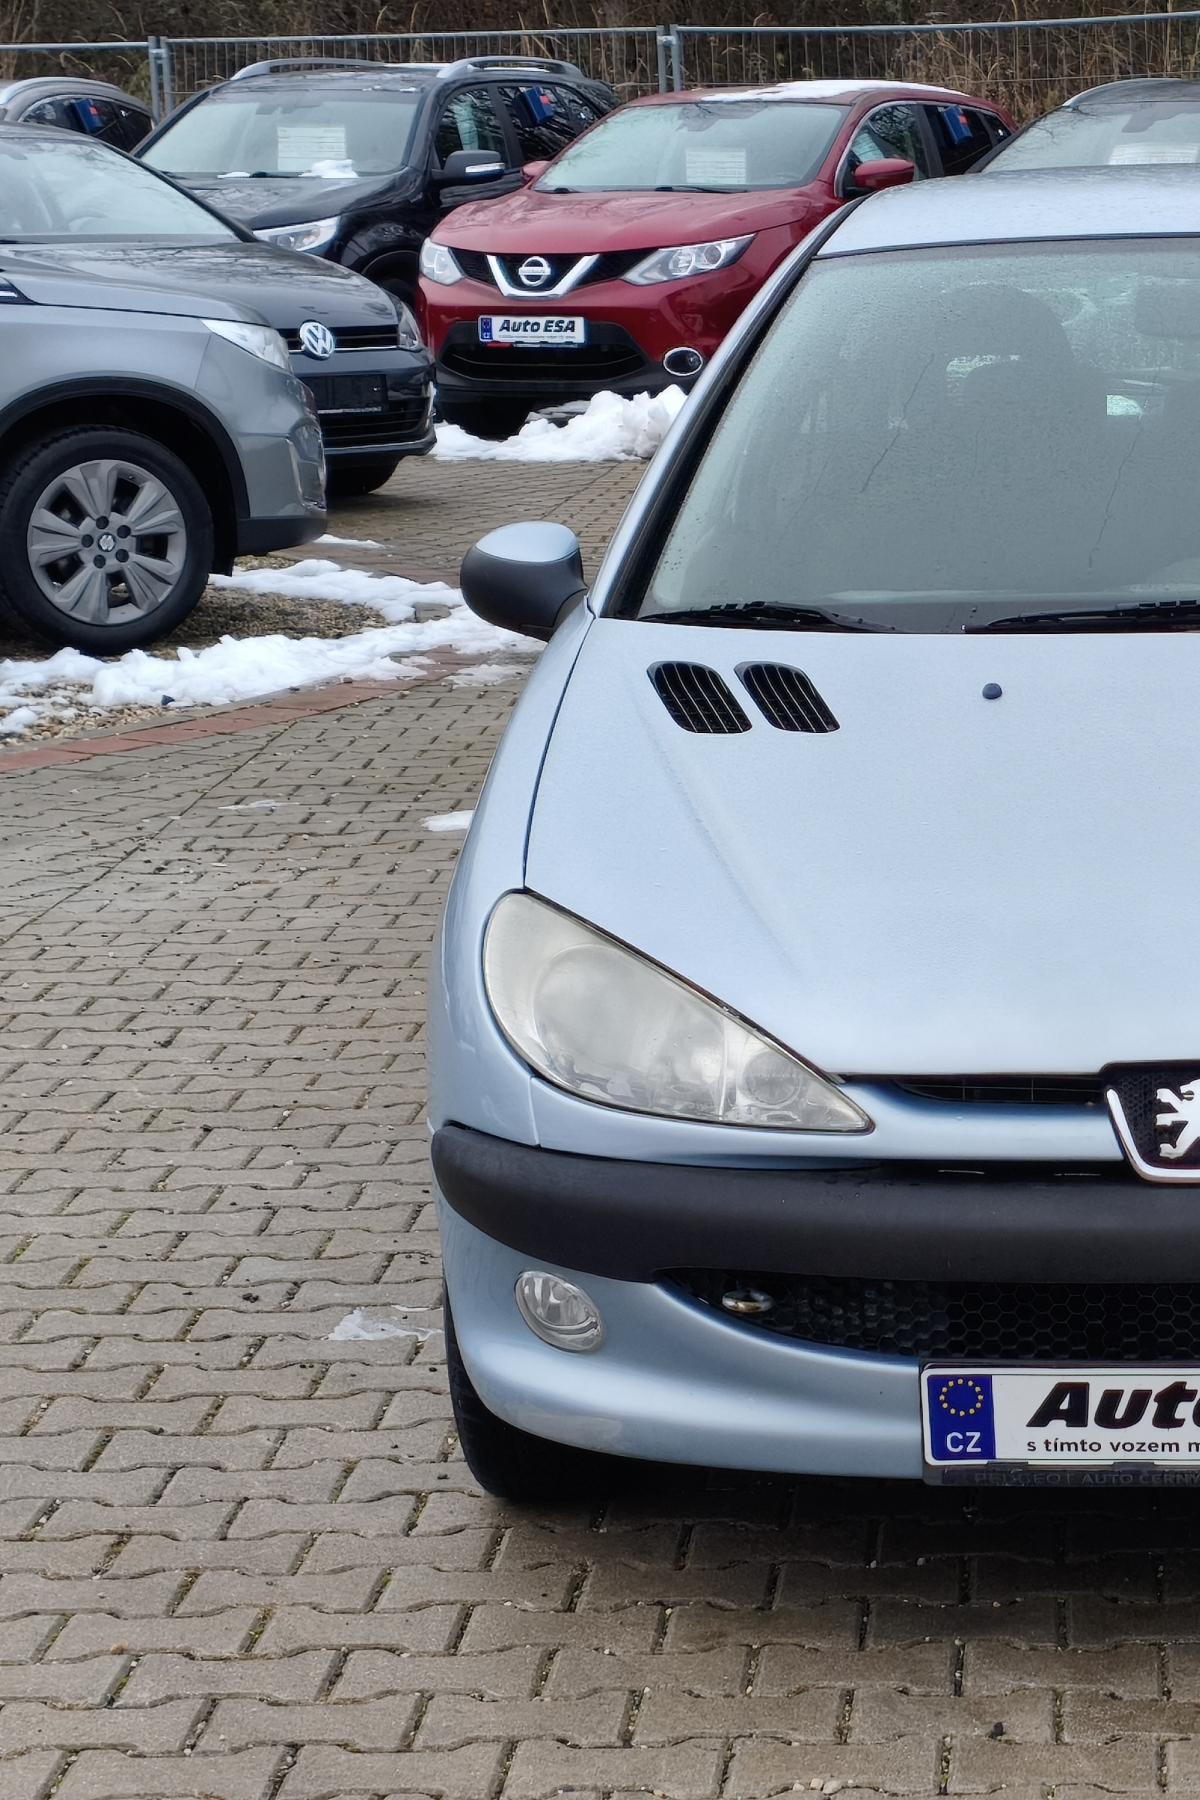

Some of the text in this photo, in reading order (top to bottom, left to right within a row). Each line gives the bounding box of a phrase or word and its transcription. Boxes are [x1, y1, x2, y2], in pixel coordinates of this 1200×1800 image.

[499, 319, 576, 333] Auto ESA
[946, 1431, 982, 1453] CZ
[1026, 1440, 1037, 1452] s
[1043, 1436, 1102, 1453] tímto
[1109, 1440, 1180, 1453] vozem
[1081, 1472, 1133, 1486] AUTO
